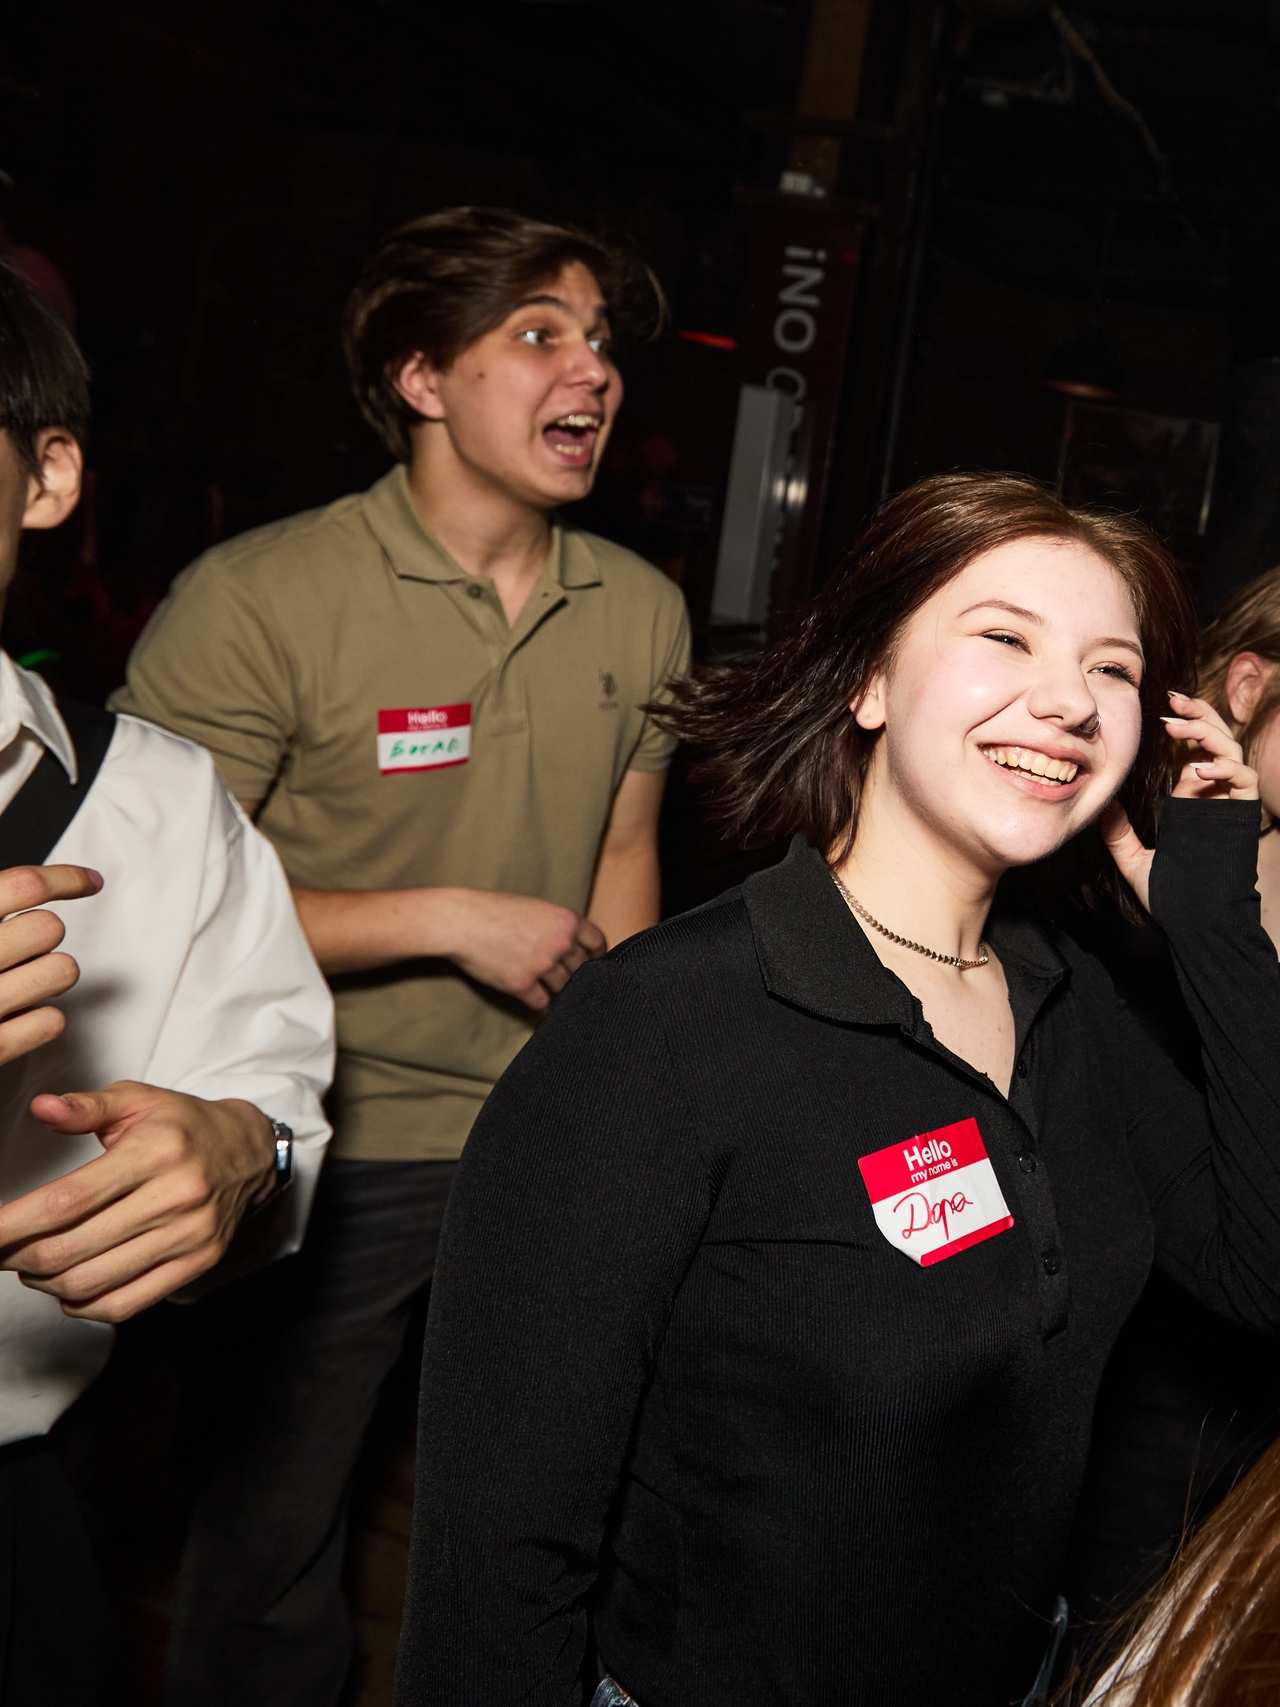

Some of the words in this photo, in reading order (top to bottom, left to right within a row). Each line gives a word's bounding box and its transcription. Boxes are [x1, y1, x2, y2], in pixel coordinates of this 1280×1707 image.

[407, 710, 448, 725] Hello
[903, 1139, 952, 1171] Hello
[911, 1169, 928, 1183] my
[929, 1162, 951, 1176] name
[950, 1158, 958, 1167] is
